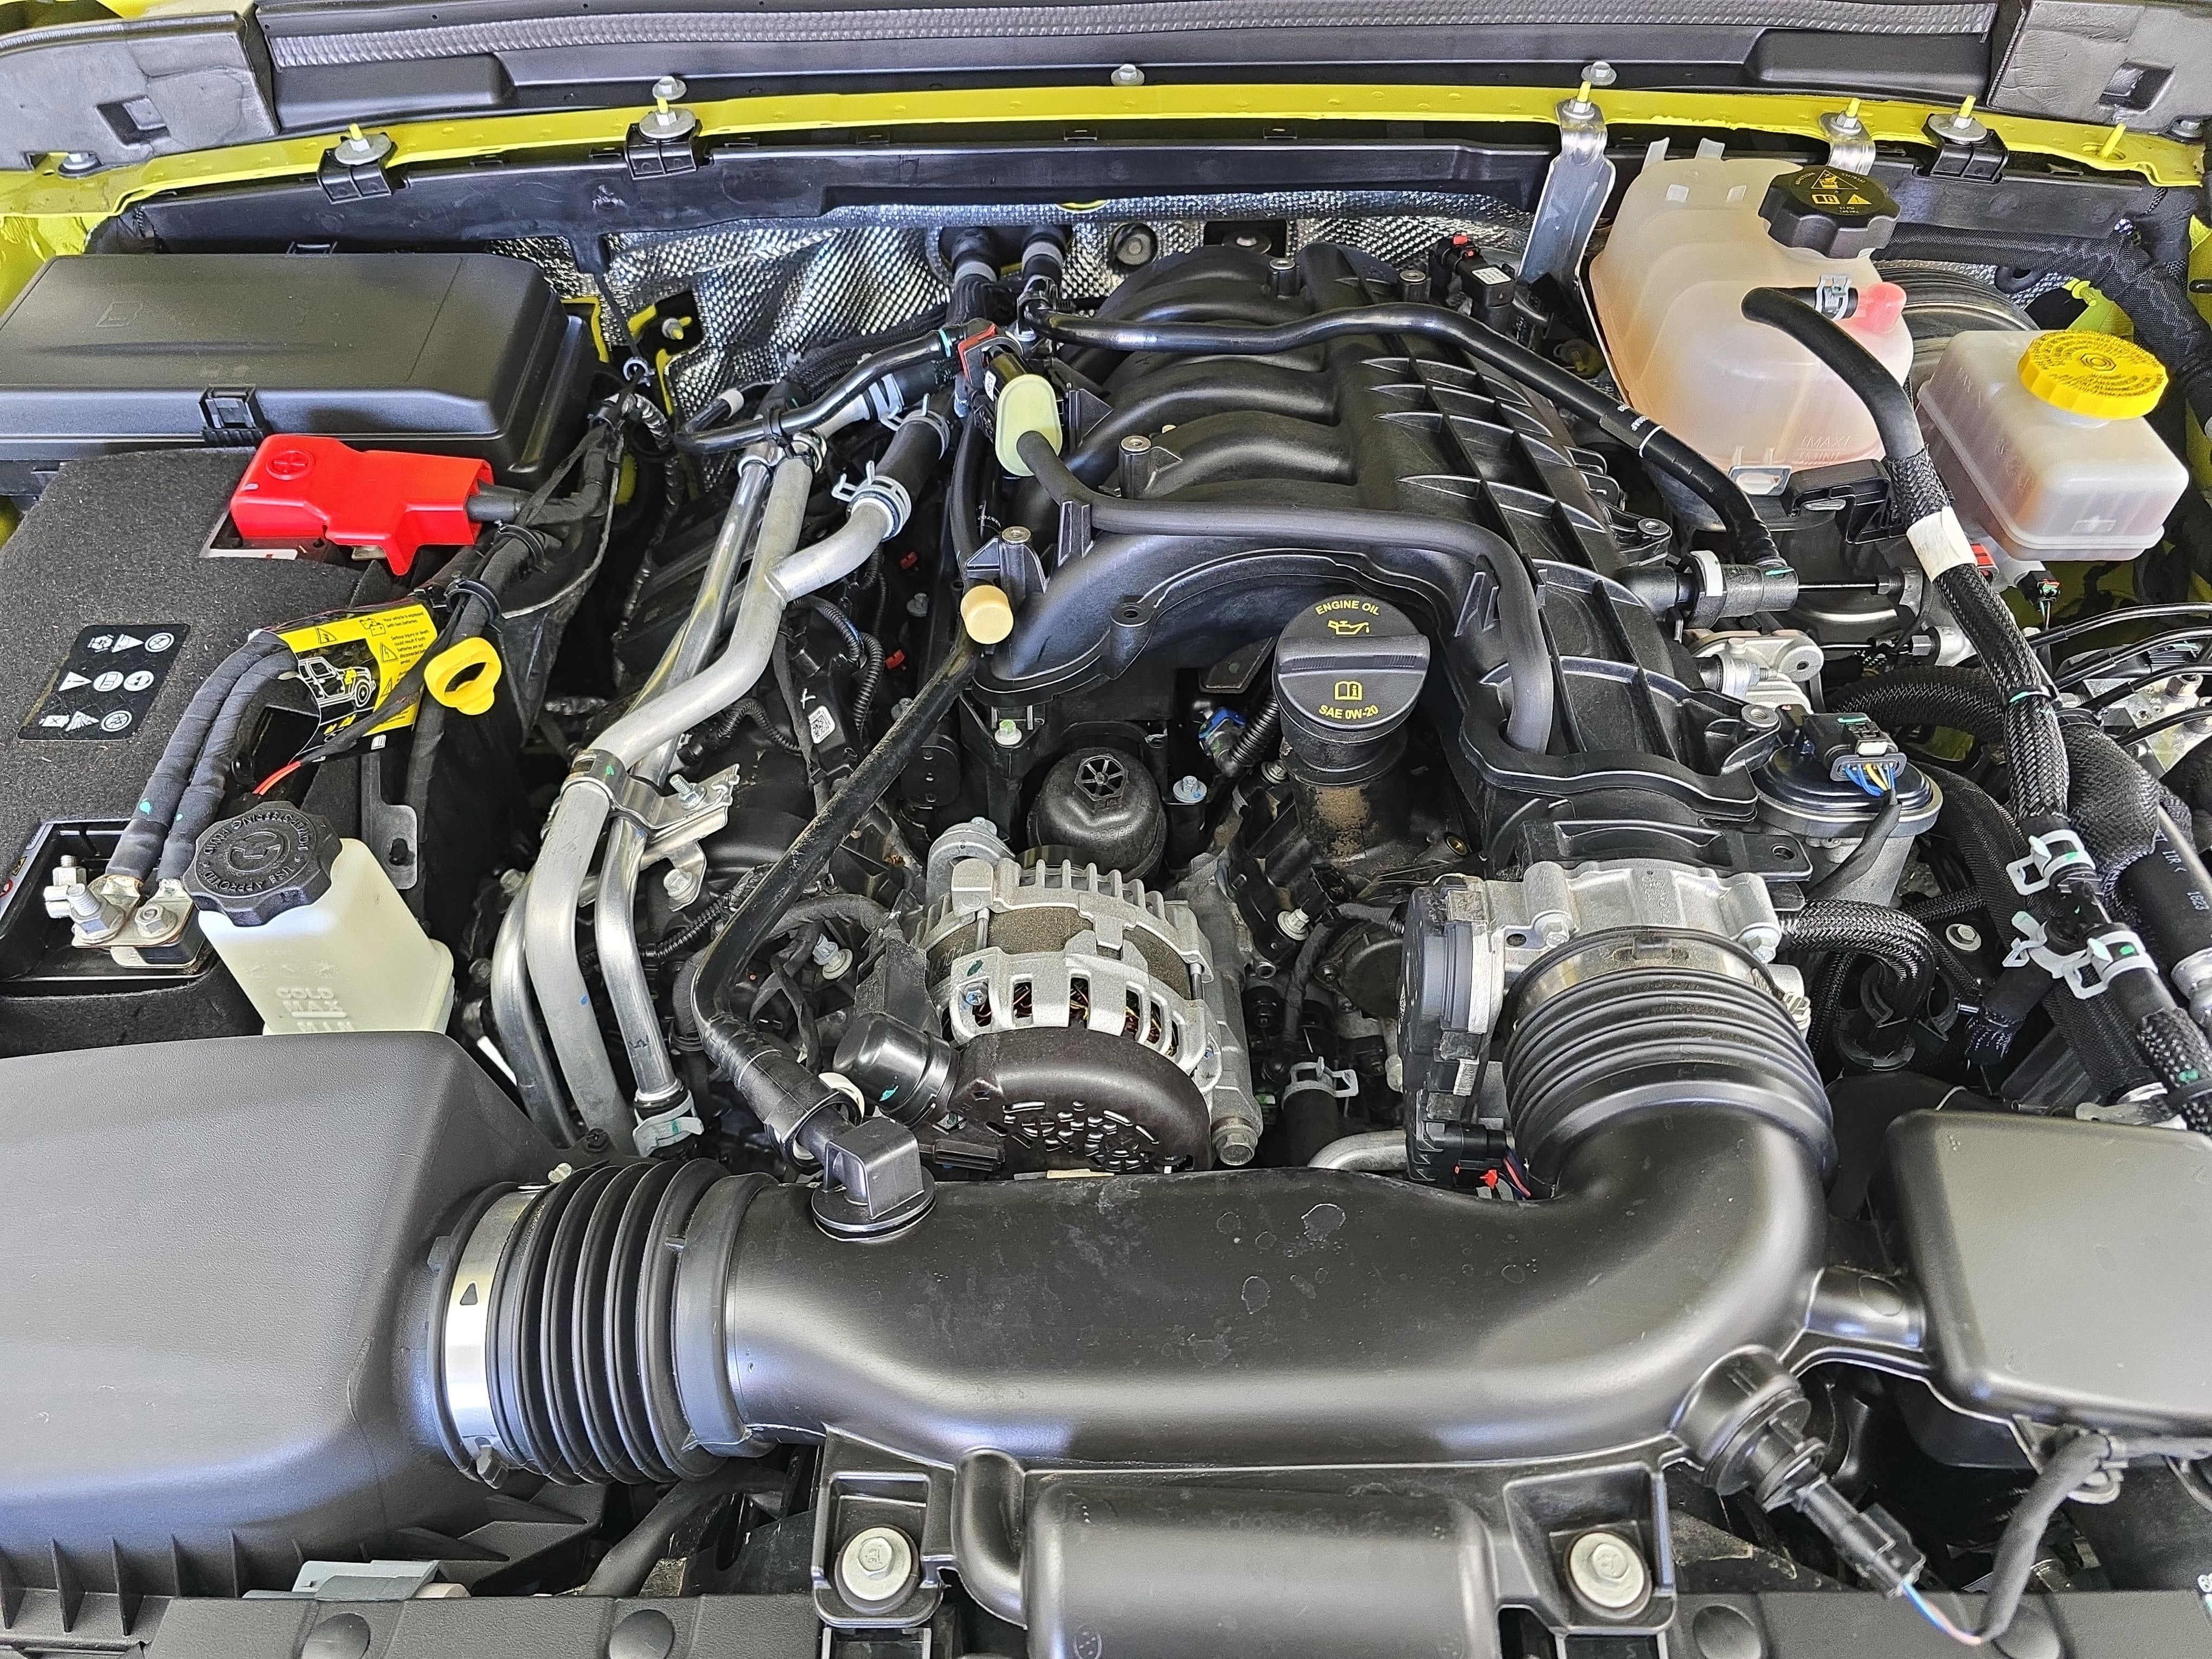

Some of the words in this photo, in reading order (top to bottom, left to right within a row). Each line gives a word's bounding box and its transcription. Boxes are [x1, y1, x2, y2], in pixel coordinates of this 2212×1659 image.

[1315, 600, 1359, 615] ENGINE
[1361, 602, 1380, 616] OIL
[1319, 704, 1342, 719] SAE
[1345, 705, 1379, 720] 0W-20
[203, 827, 231, 856] FLUID
[203, 870, 266, 893] APPROVED
[2186, 891, 2210, 911] 1823
[275, 987, 335, 1000] COLD
[282, 1000, 344, 1012] MAX
[297, 1021, 355, 1033] MIN
